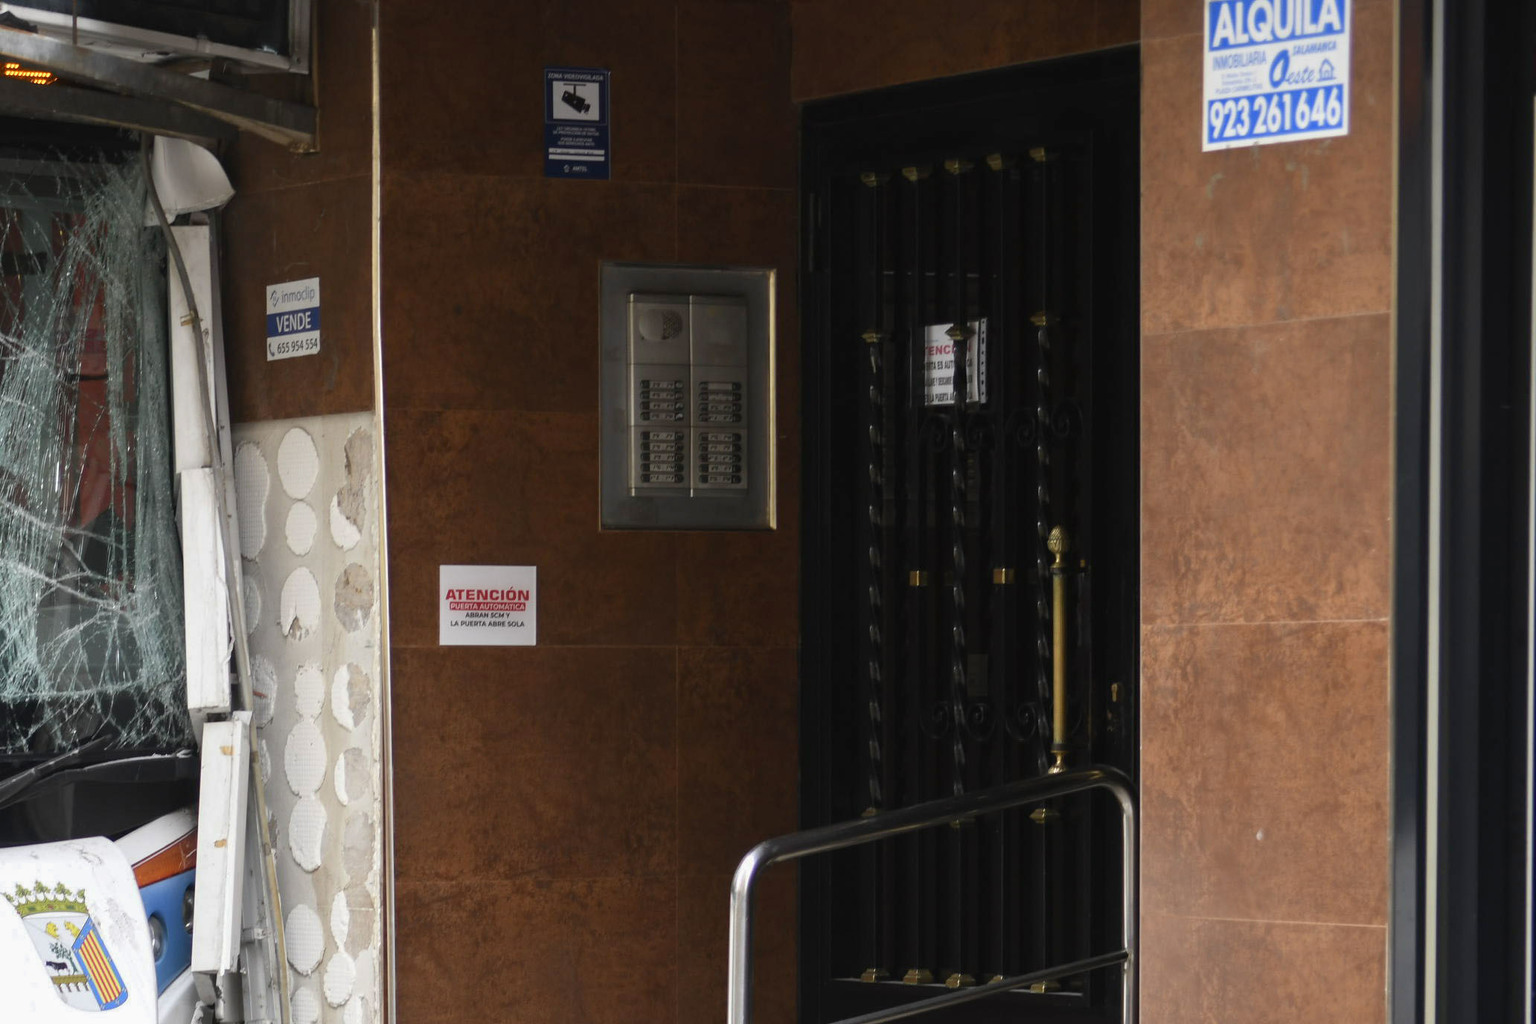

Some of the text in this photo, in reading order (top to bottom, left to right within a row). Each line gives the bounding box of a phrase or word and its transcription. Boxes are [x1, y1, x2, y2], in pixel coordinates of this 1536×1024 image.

[1212, 0, 1342, 48] ALQUILA
[1292, 41, 1337, 56] SALAMANCA
[1212, 51, 1267, 71] INMOBILIARIA
[1209, 87, 1342, 140] 923 261 646
[276, 311, 312, 334] VENDE
[277, 338, 318, 355] 655 954 554
[445, 586, 530, 601] ATENCIÓN
[450, 602, 478, 611] PUERTA
[507, 620, 525, 628] SOLA
